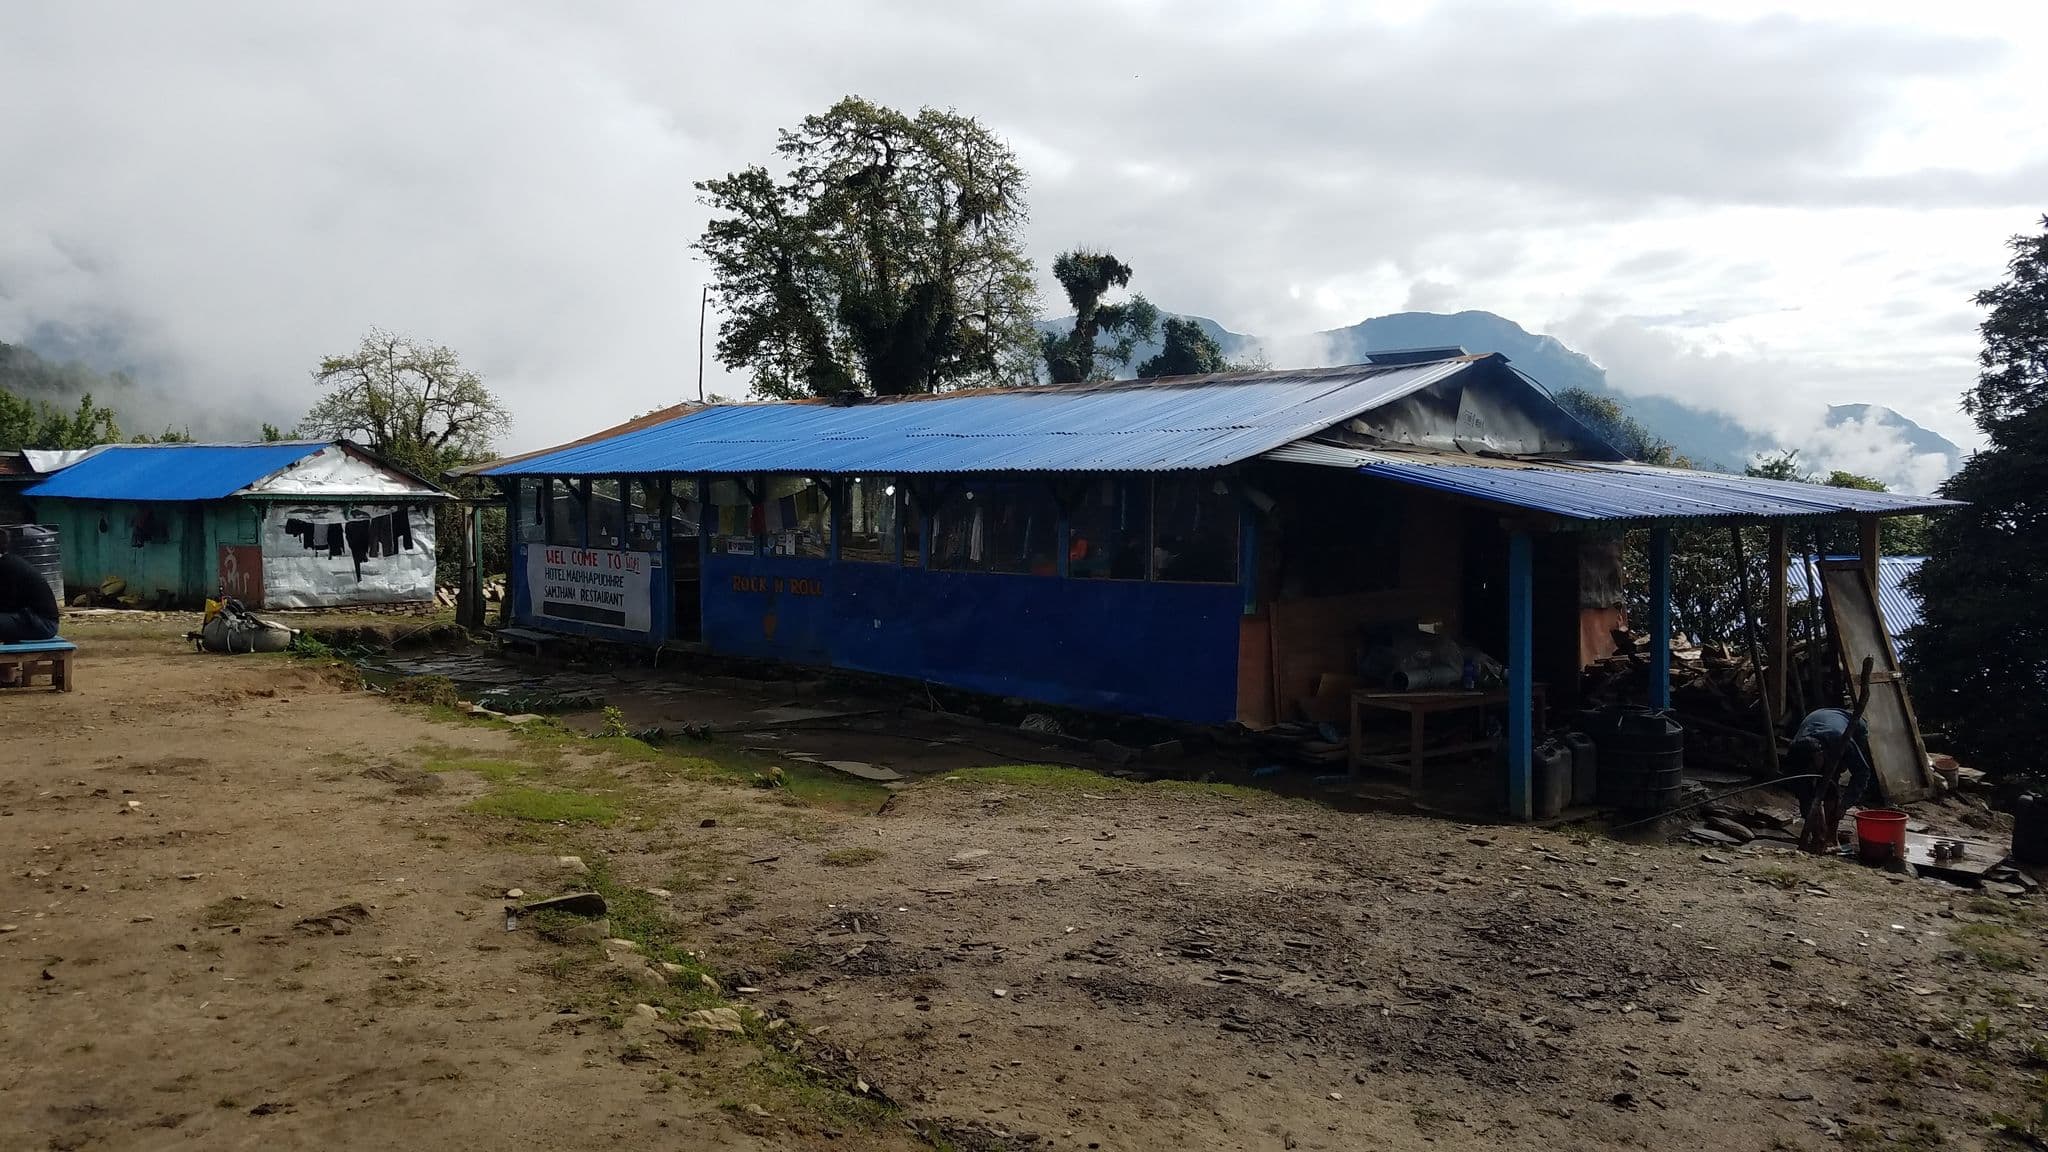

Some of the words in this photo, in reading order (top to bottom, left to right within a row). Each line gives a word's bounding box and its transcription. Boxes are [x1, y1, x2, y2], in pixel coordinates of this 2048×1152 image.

[545, 549, 566, 565] WEL
[571, 550, 598, 567] COME
[607, 552, 622, 570] TO
[544, 567, 566, 582] HOTEL
[732, 575, 768, 593] ROCK
[789, 577, 824, 596] ROLL
[580, 588, 625, 607] RESTAURANT
